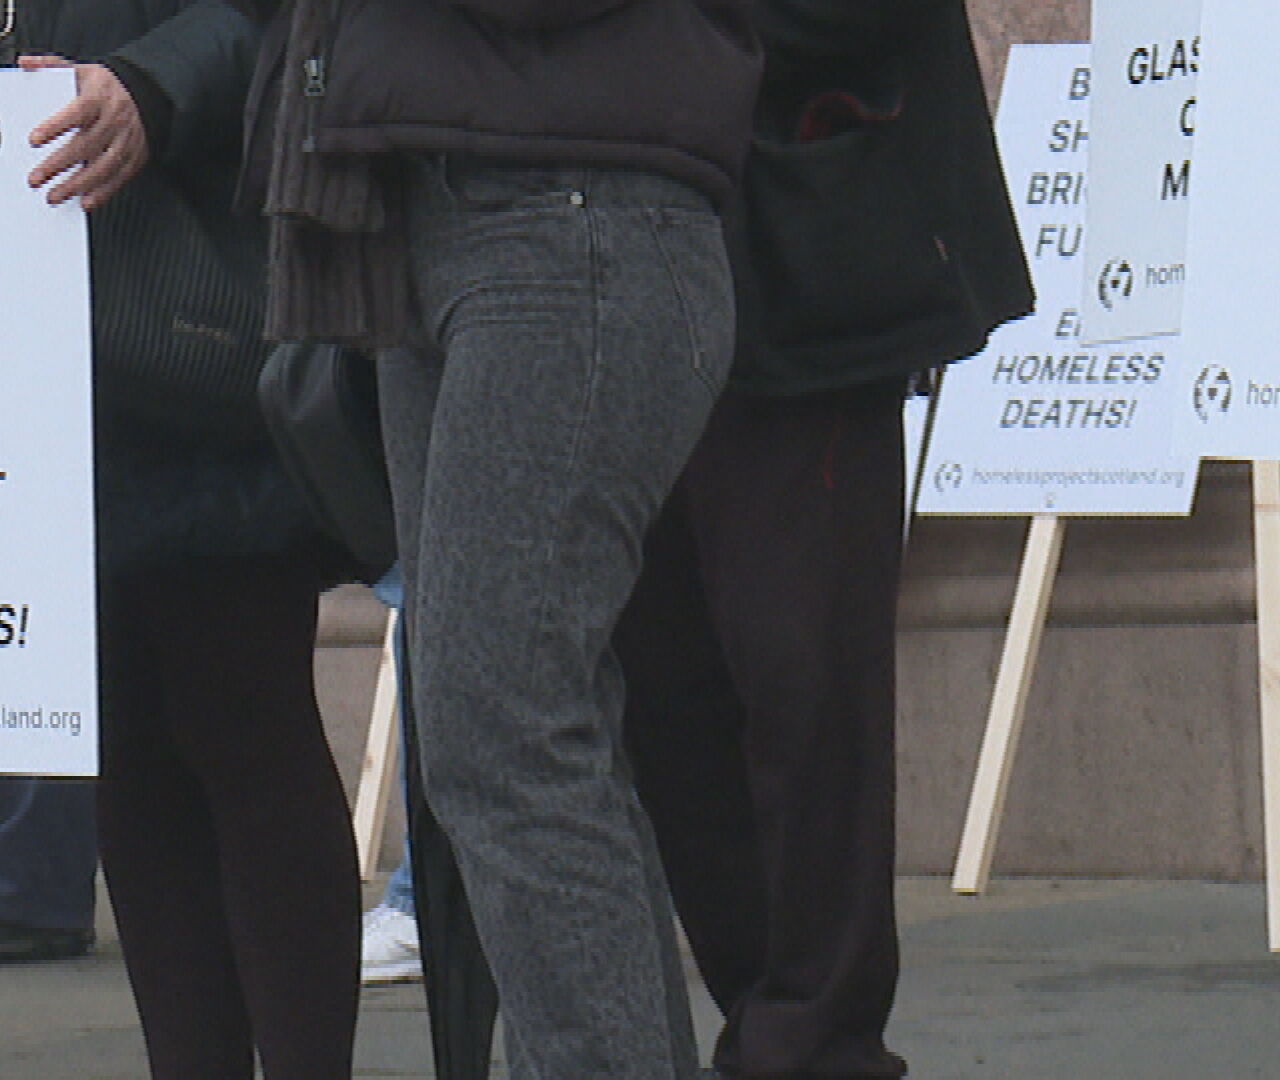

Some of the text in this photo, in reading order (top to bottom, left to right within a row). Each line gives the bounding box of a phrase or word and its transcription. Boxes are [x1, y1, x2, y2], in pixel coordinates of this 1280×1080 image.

[1027, 171, 1088, 205] BRI
[1036, 228, 1082, 256] FU
[993, 356, 1164, 384] HOMELESS
[1000, 400, 1137, 428] DEATHS!
